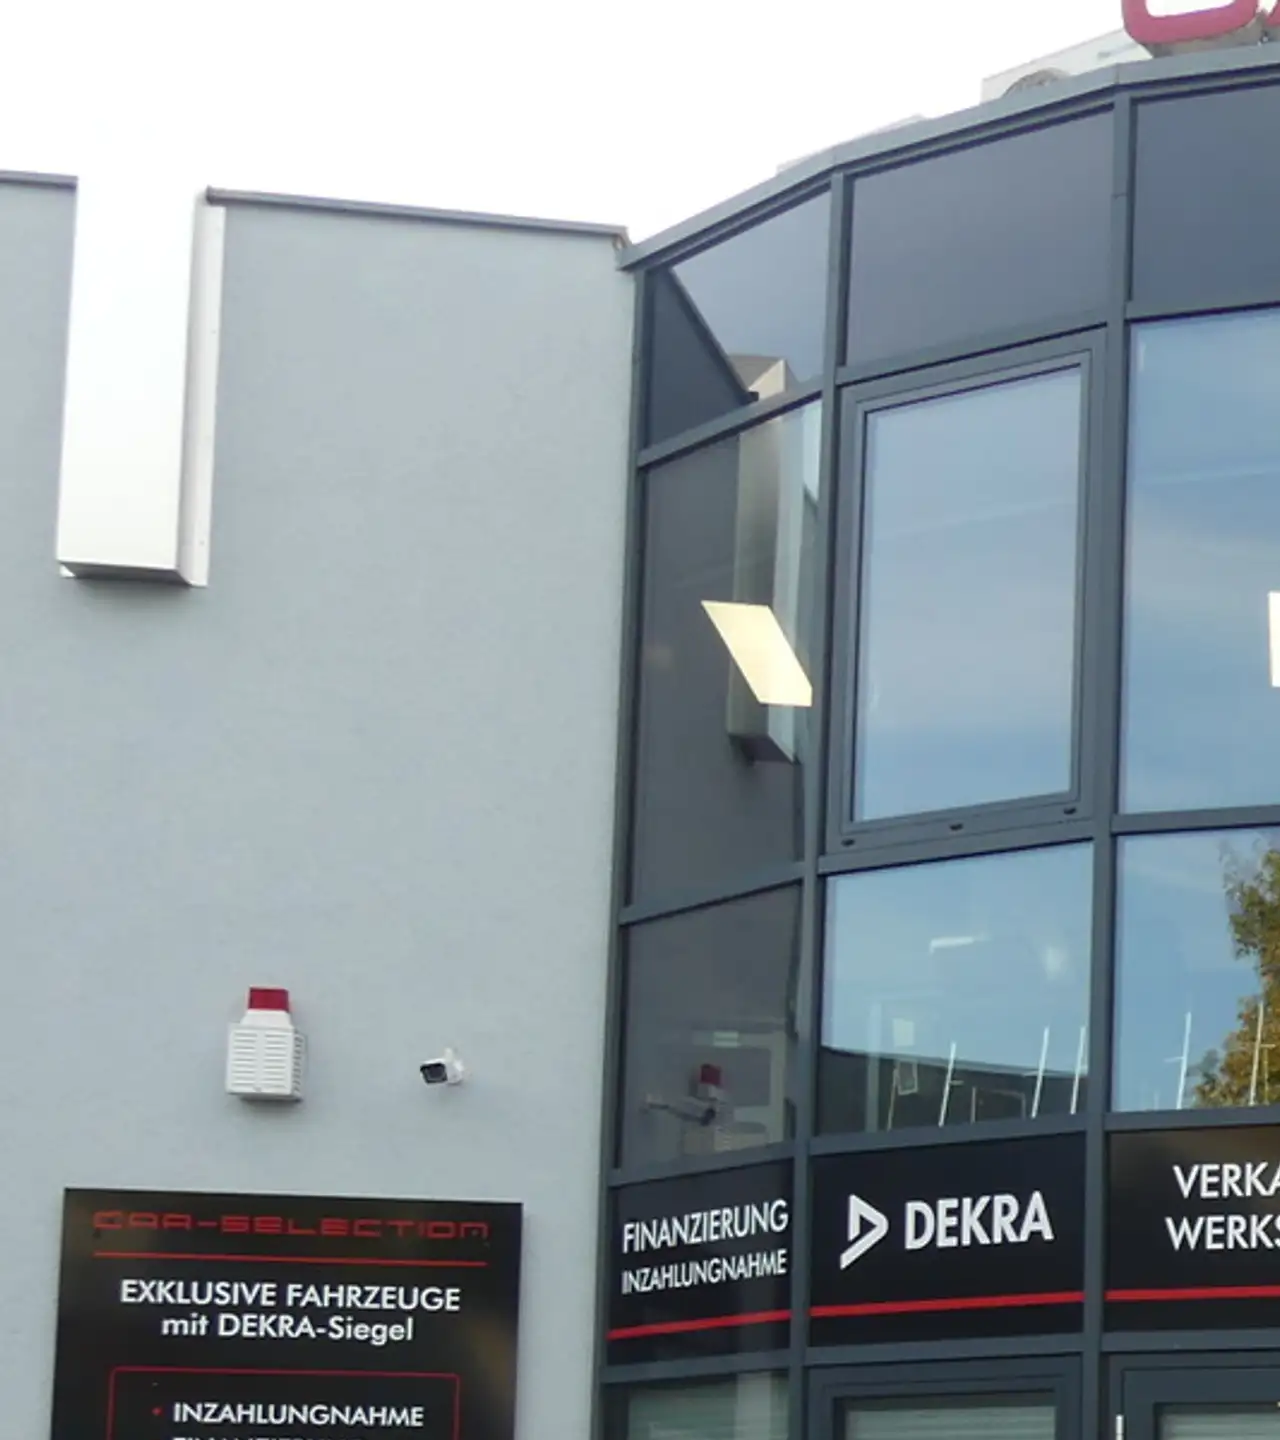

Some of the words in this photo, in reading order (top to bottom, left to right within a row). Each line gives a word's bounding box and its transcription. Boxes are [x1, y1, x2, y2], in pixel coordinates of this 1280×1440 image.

[94, 1210, 489, 1240] CAR-SELECTION
[622, 1199, 789, 1254] FINANZIERUNG
[904, 1190, 1054, 1251] DEKRA
[621, 1246, 787, 1295] INZAHLUNGNAHME
[120, 1279, 277, 1307] EXKLUSIVE
[286, 1283, 461, 1312] FAHRZEUGE
[161, 1312, 209, 1337] mit
[218, 1313, 414, 1346] DEKRA-Siegel
[173, 1403, 424, 1428] INZAHLUNGNAHME
